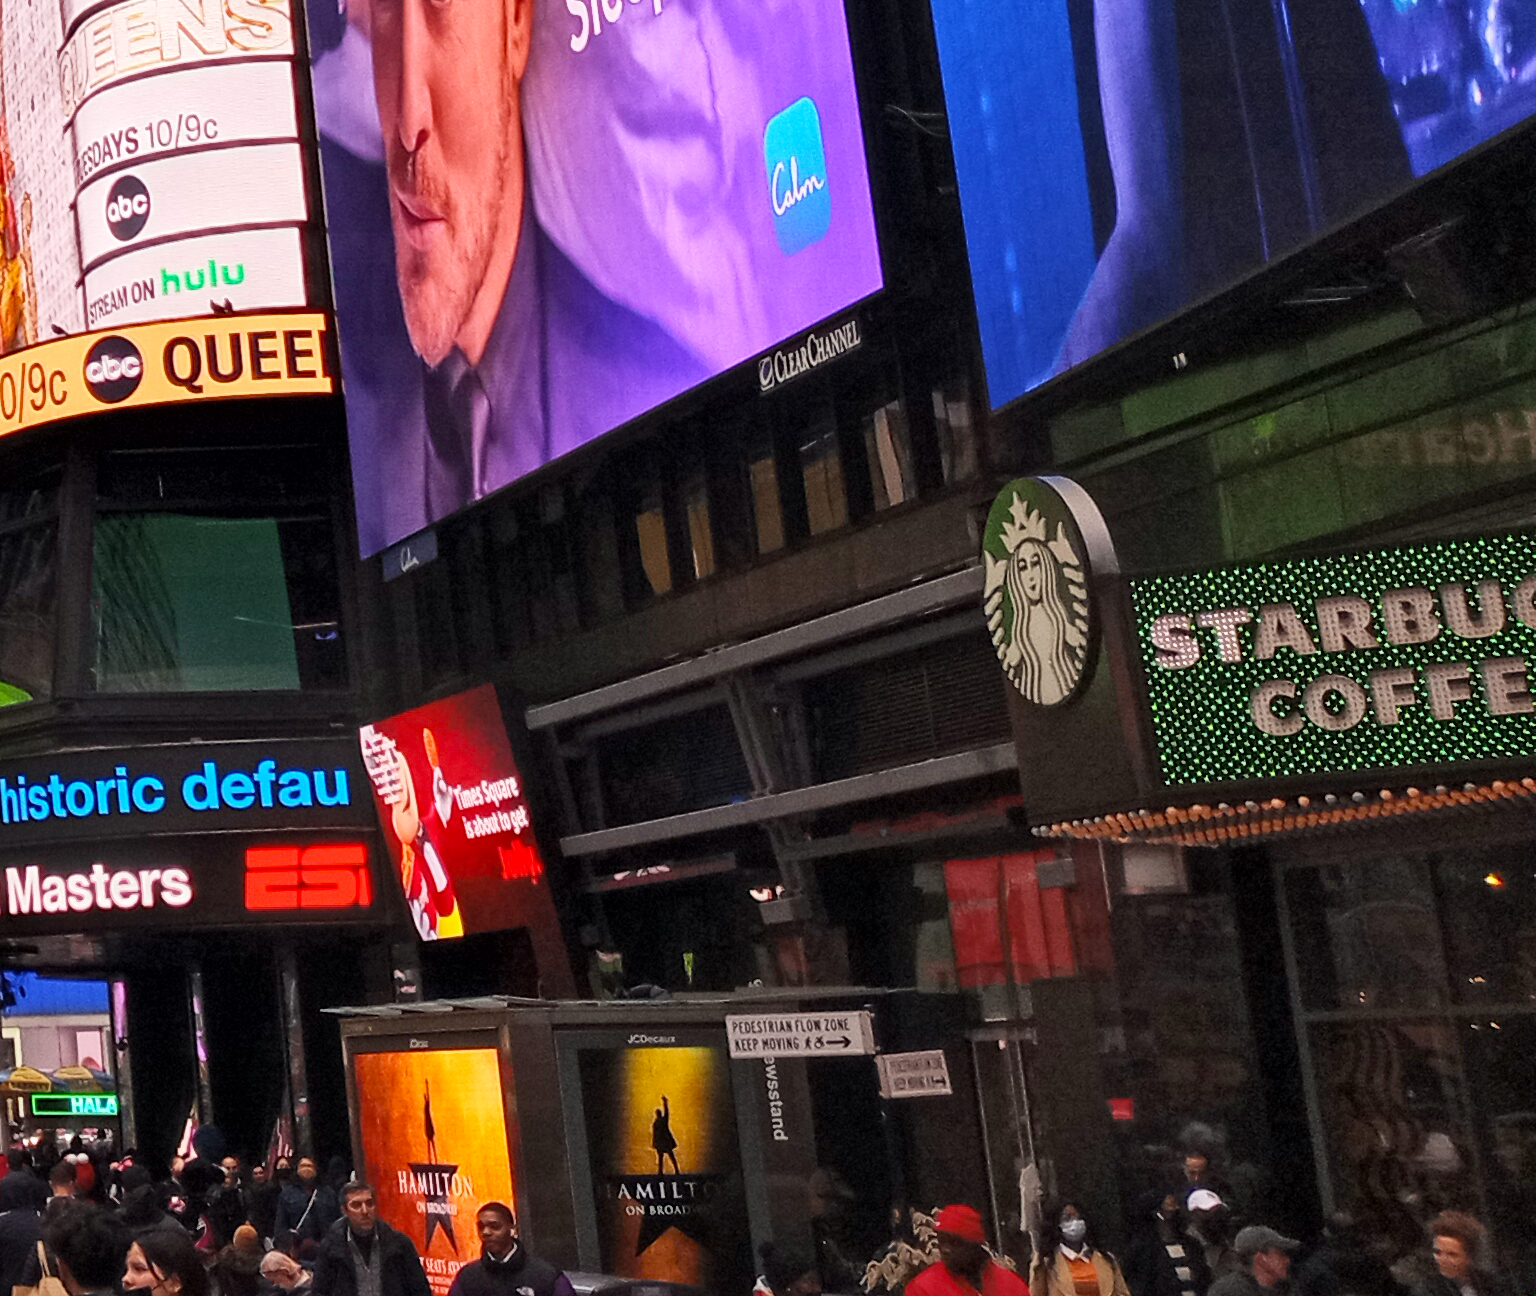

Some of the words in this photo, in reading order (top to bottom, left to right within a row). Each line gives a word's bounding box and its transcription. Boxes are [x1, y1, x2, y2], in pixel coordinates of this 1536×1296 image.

[145, 114, 219, 149] 10/9c
[107, 193, 148, 223] abc
[771, 165, 825, 217] Calm
[89, 290, 129, 325] STREAM
[131, 278, 156, 305] ON
[161, 259, 246, 295] hulu
[85, 357, 143, 384] abc
[181, 759, 350, 811] defau
[453, 784, 485, 811] Times
[480, 776, 520, 808] Square
[462, 815, 475, 840] is
[472, 811, 502, 838] about
[498, 809, 510, 831] to
[508, 805, 530, 835] get
[5, 862, 194, 916] Masters
[627, 1033, 676, 1045] JCDecaux
[732, 1019, 793, 1035] PEDESTRIAN
[795, 1018, 822, 1033] FLOW
[823, 1017, 851, 1032] ZONE
[734, 1038, 759, 1052] KEEP
[762, 1036, 800, 1051] MOVING
[762, 1056, 789, 1142] ewsstand
[397, 1170, 474, 1198] HAMILTON
[625, 1205, 646, 1216] ON
